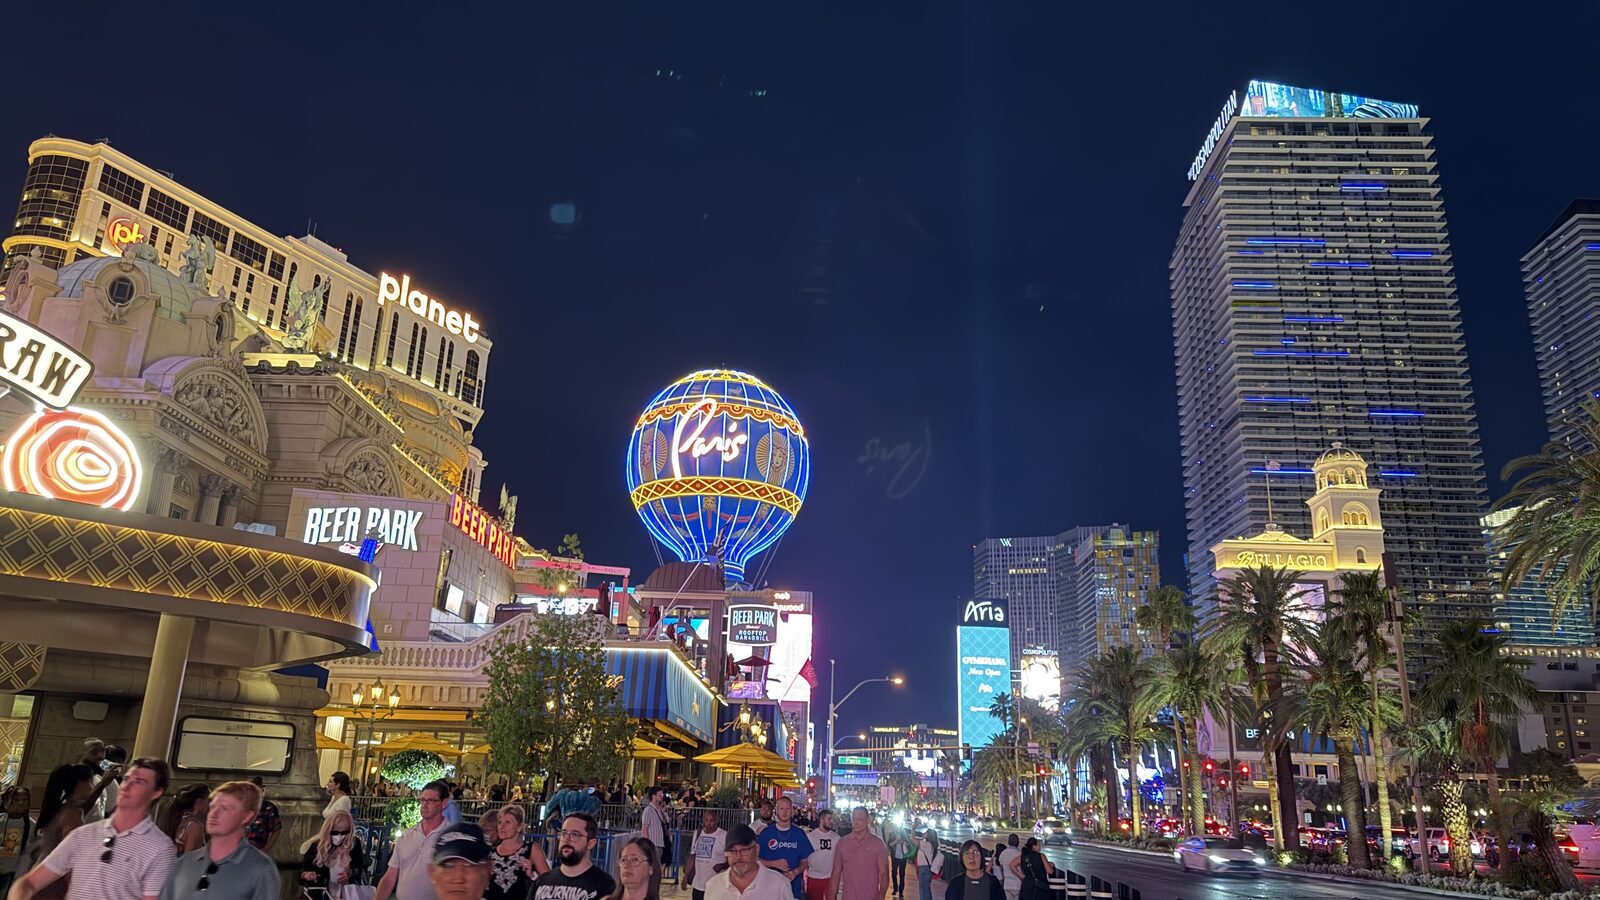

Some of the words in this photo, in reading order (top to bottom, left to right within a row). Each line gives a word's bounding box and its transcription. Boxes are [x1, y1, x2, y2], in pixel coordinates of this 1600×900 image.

[1192, 90, 1237, 181] COSMOPOLITAN
[377, 272, 480, 344] planet
[671, 398, 748, 481] Paris
[303, 507, 361, 545] BEER
[365, 507, 423, 551] PARK
[452, 494, 487, 546] BEER
[488, 523, 518, 570] PARK
[1232, 551, 1328, 568] BELLAGIO
[732, 610, 753, 626] BEER
[754, 610, 775, 627] PARK
[964, 601, 1004, 622] Aria
[1022, 648, 1058, 656] COSMOPOLITAN
[778, 841, 798, 849] pepsi
